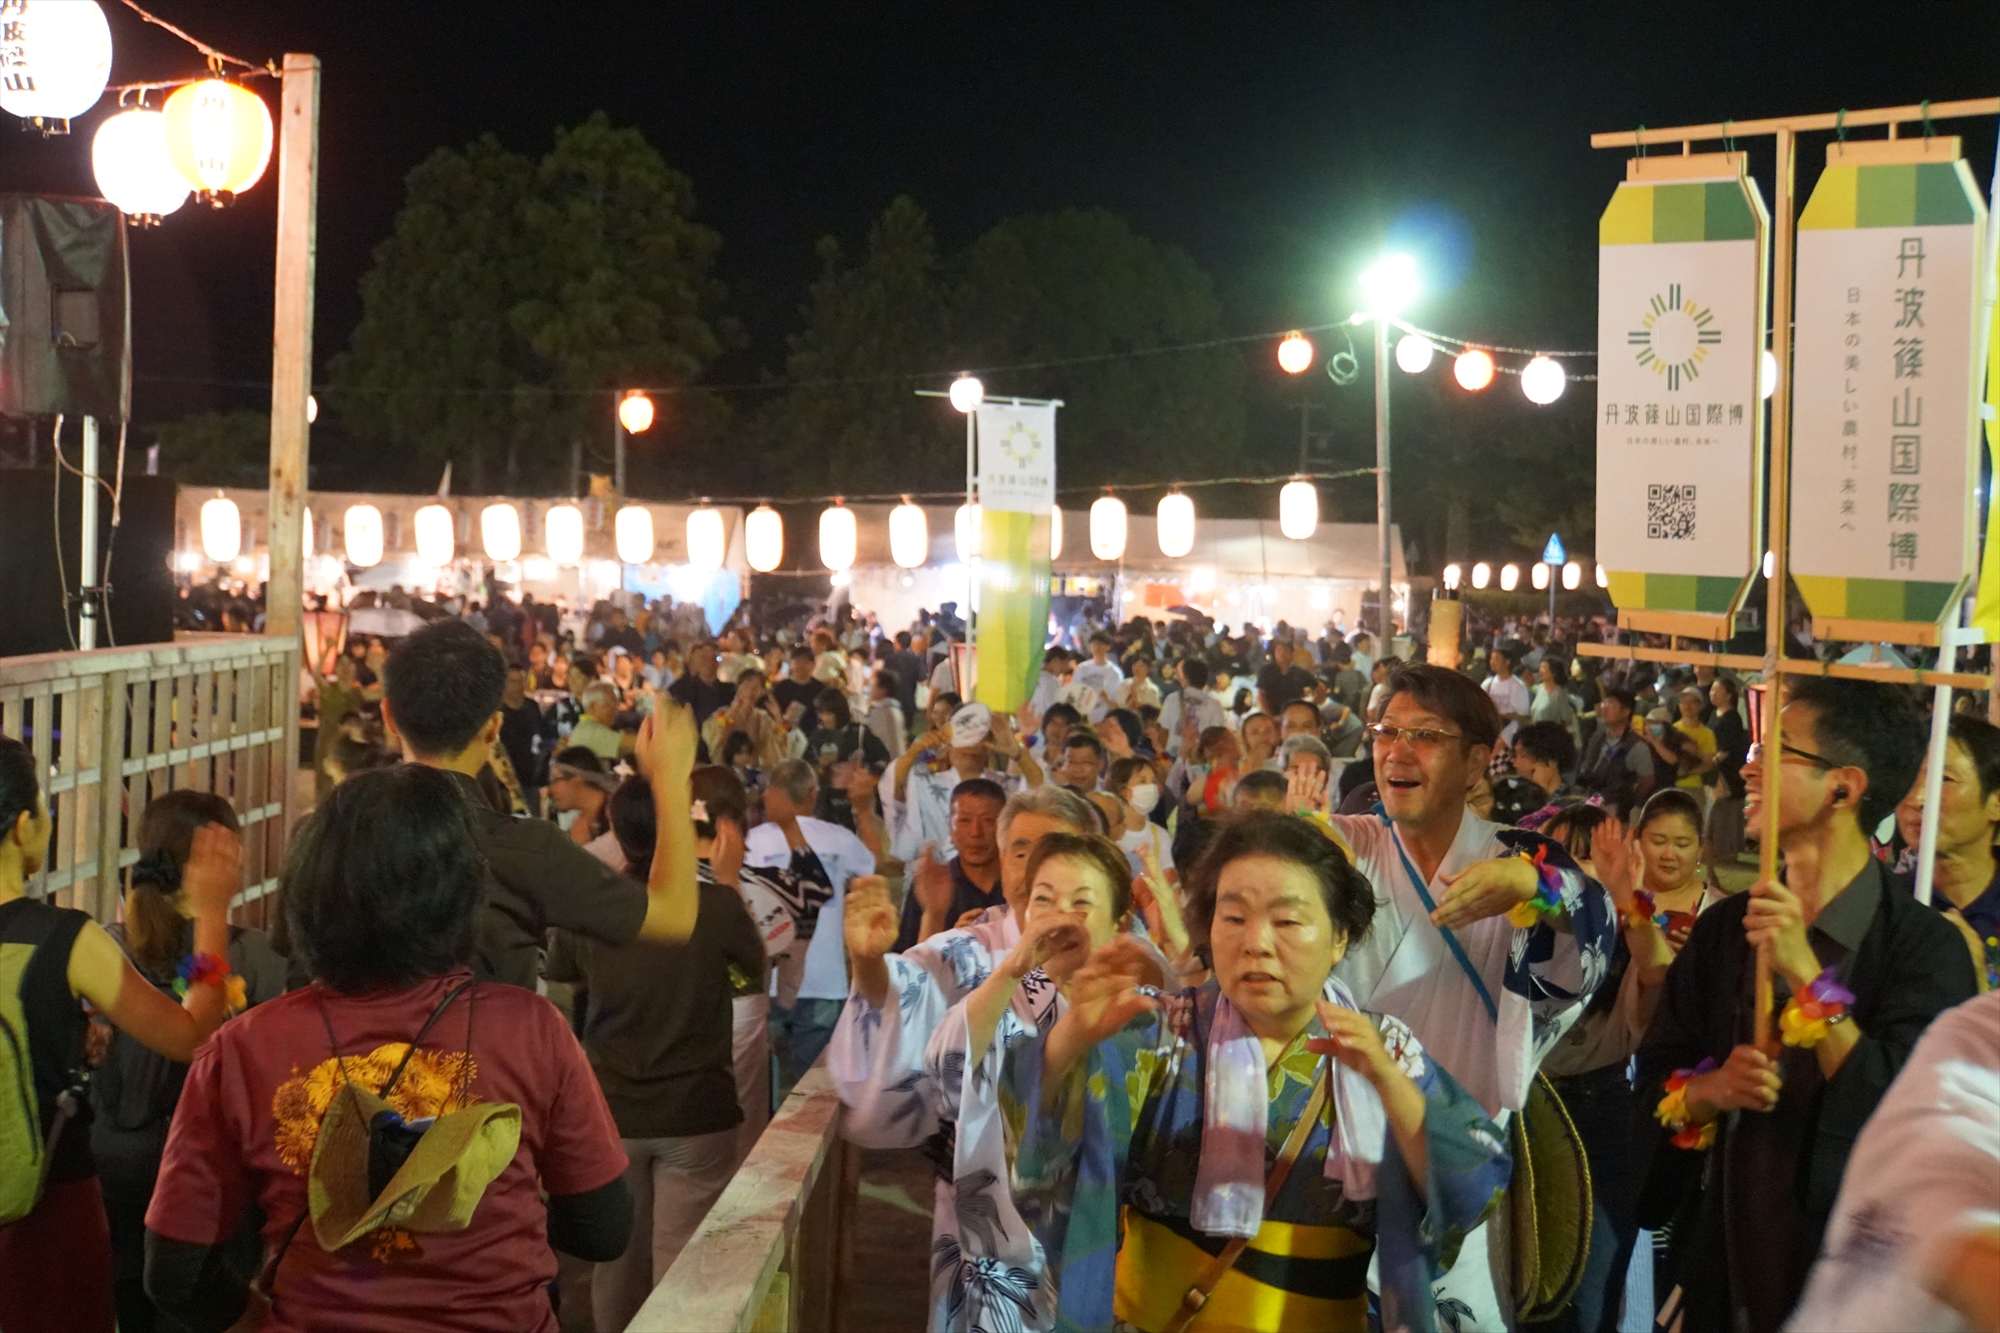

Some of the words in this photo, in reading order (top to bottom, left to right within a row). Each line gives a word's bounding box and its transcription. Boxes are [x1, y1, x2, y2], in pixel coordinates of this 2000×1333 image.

[1605, 403, 1744, 426] 丹波篠山国際博
[1887, 237, 1926, 571] 丹波篠山国際博
